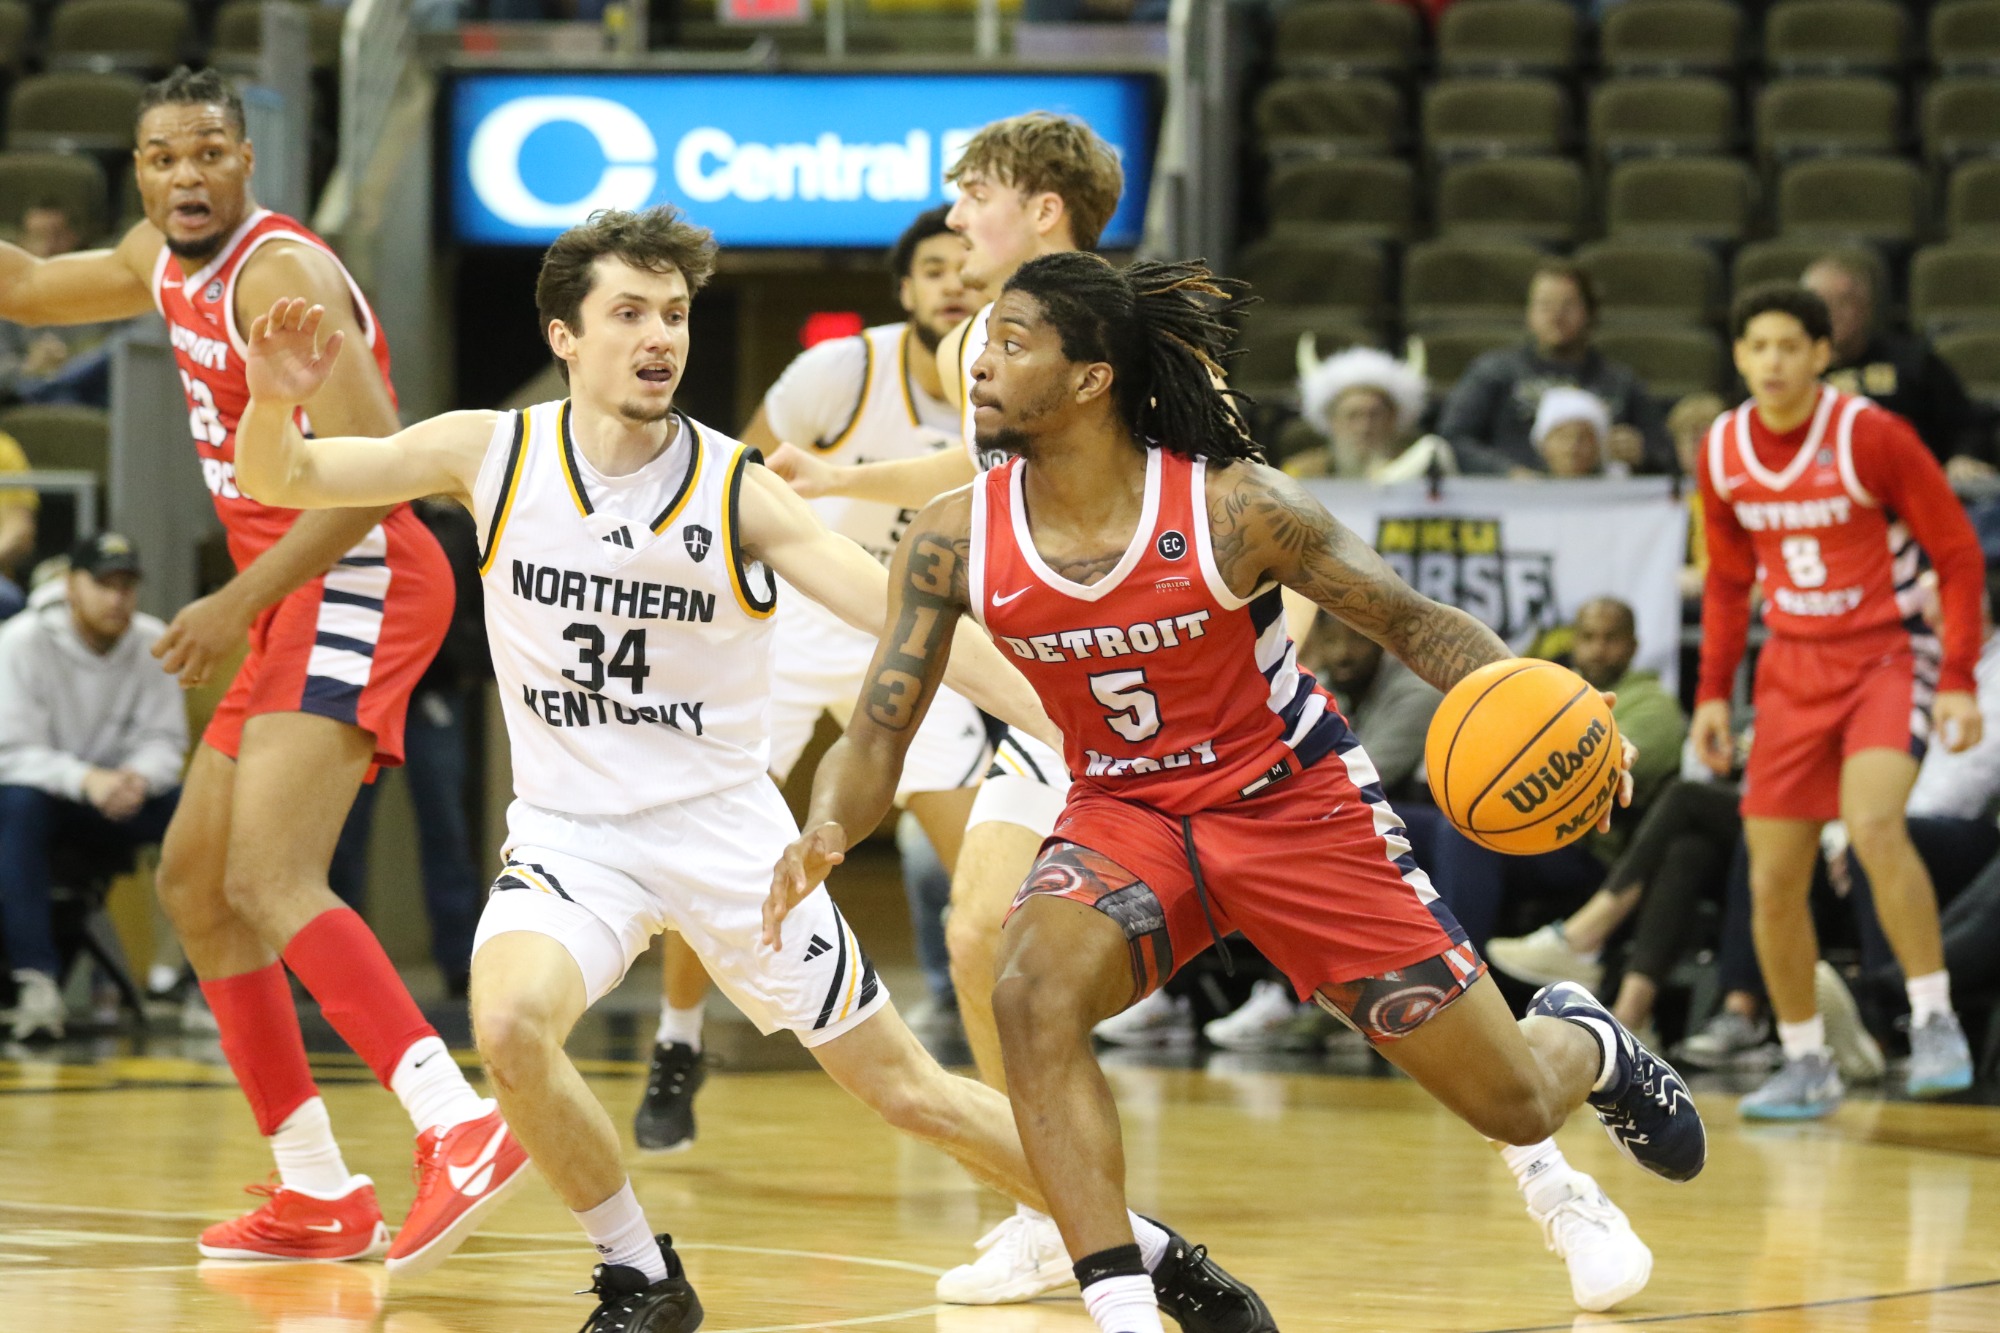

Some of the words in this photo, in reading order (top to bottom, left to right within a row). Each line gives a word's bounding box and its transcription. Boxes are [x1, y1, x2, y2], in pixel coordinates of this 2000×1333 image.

[674, 127, 930, 202] Central
[1381, 520, 1498, 553] NKU
[1734, 495, 1850, 531] DETROIT
[1163, 537, 1181, 553] EC
[1781, 534, 1828, 588] 8
[512, 559, 716, 623] NORTHERN
[1155, 580, 1191, 589] HORIZON
[561, 622, 651, 695] 34
[1001, 610, 1211, 664] DETROIT
[1087, 667, 1164, 743] 5
[1271, 763, 1283, 776] M
[1501, 717, 1606, 814] Wilson
[1555, 765, 1618, 841] NCAA
